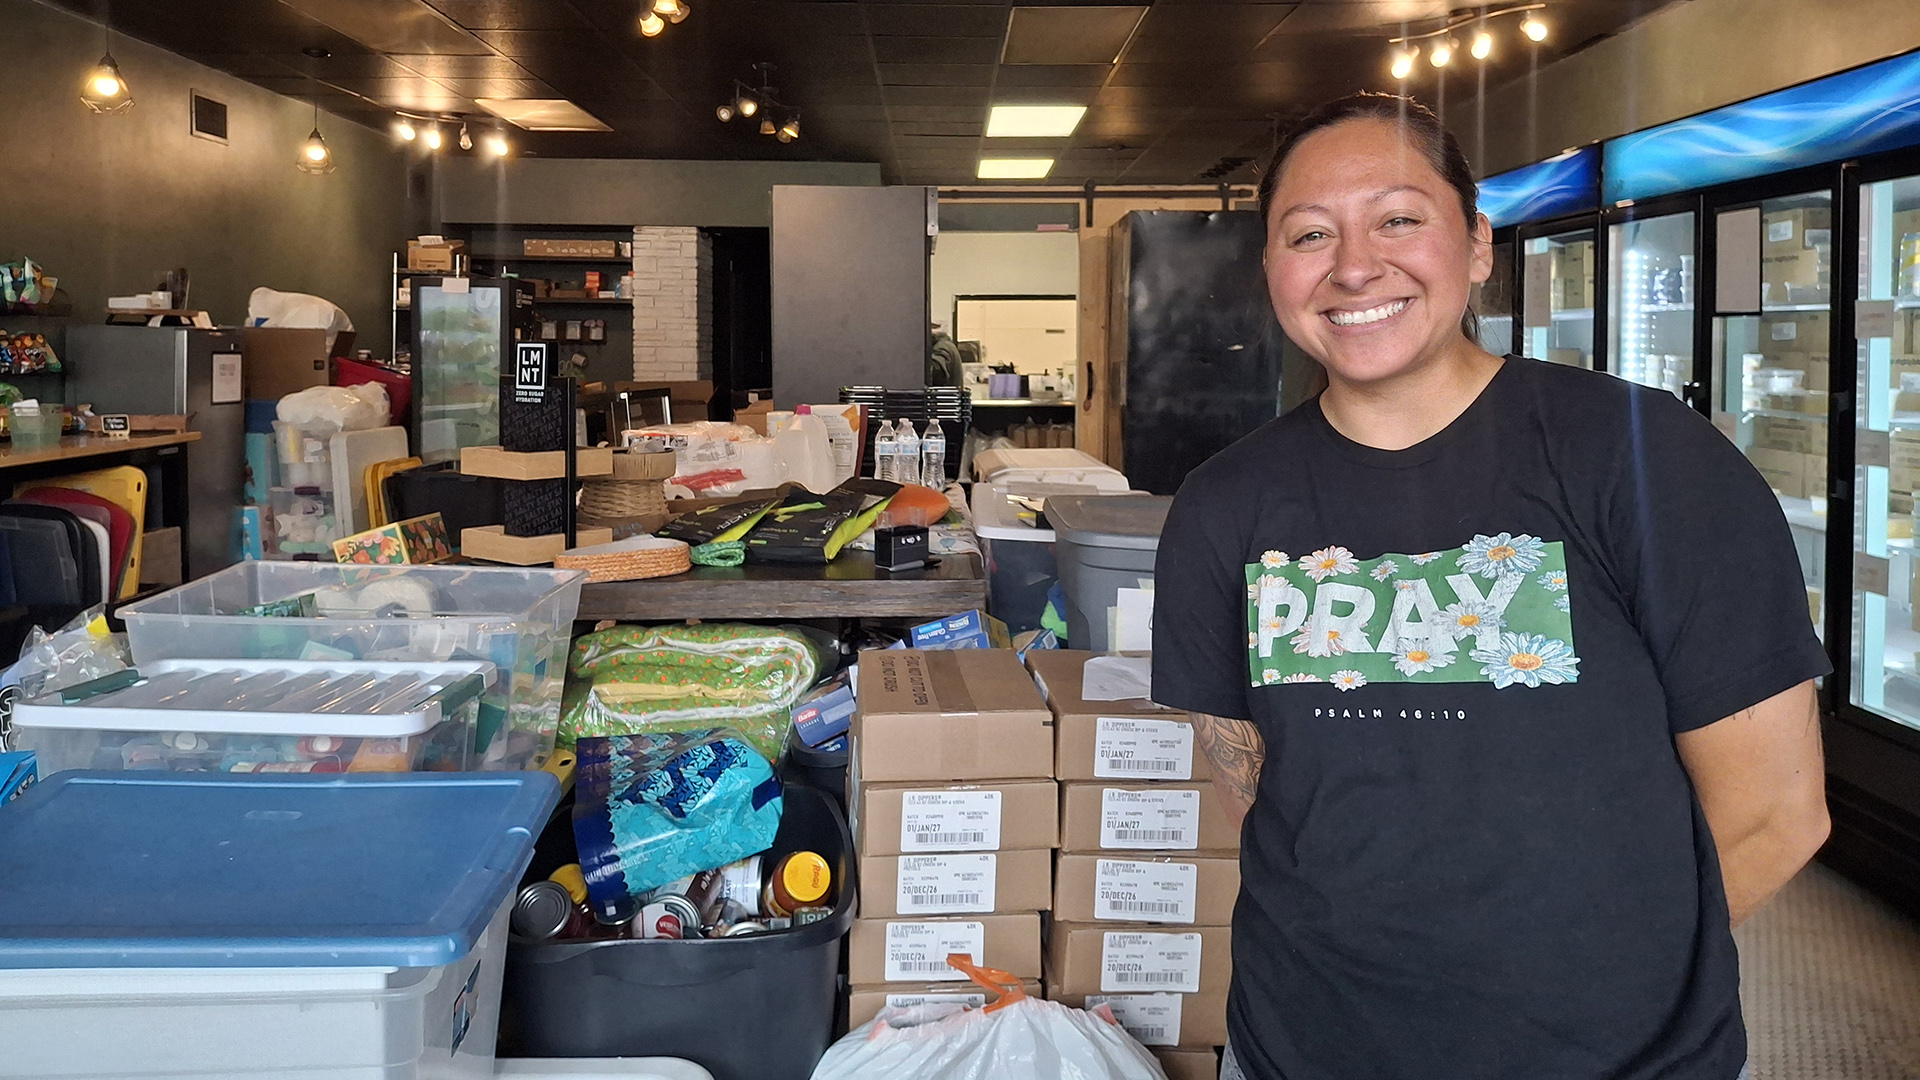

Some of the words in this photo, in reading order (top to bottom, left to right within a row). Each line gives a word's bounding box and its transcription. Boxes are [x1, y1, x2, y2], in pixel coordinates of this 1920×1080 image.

[522, 350, 541, 365] LM
[521, 367, 540, 383] NT
[1258, 573, 1526, 658] PRAY
[797, 708, 818, 723] Barilla
[1314, 708, 1383, 719] PSALM
[1399, 709, 1467, 720] 46:10
[1100, 750, 1134, 759] 01/JAN/27
[906, 824, 941, 833] 01/JAN/27
[1106, 821, 1140, 829] 01/JAN/27
[903, 885, 938, 895] 20/DEC/26
[1101, 891, 1137, 900] 20/DEC/26
[891, 953, 926, 962] 20/DEC/26
[1107, 963, 1142, 972] 20/DEC/26
